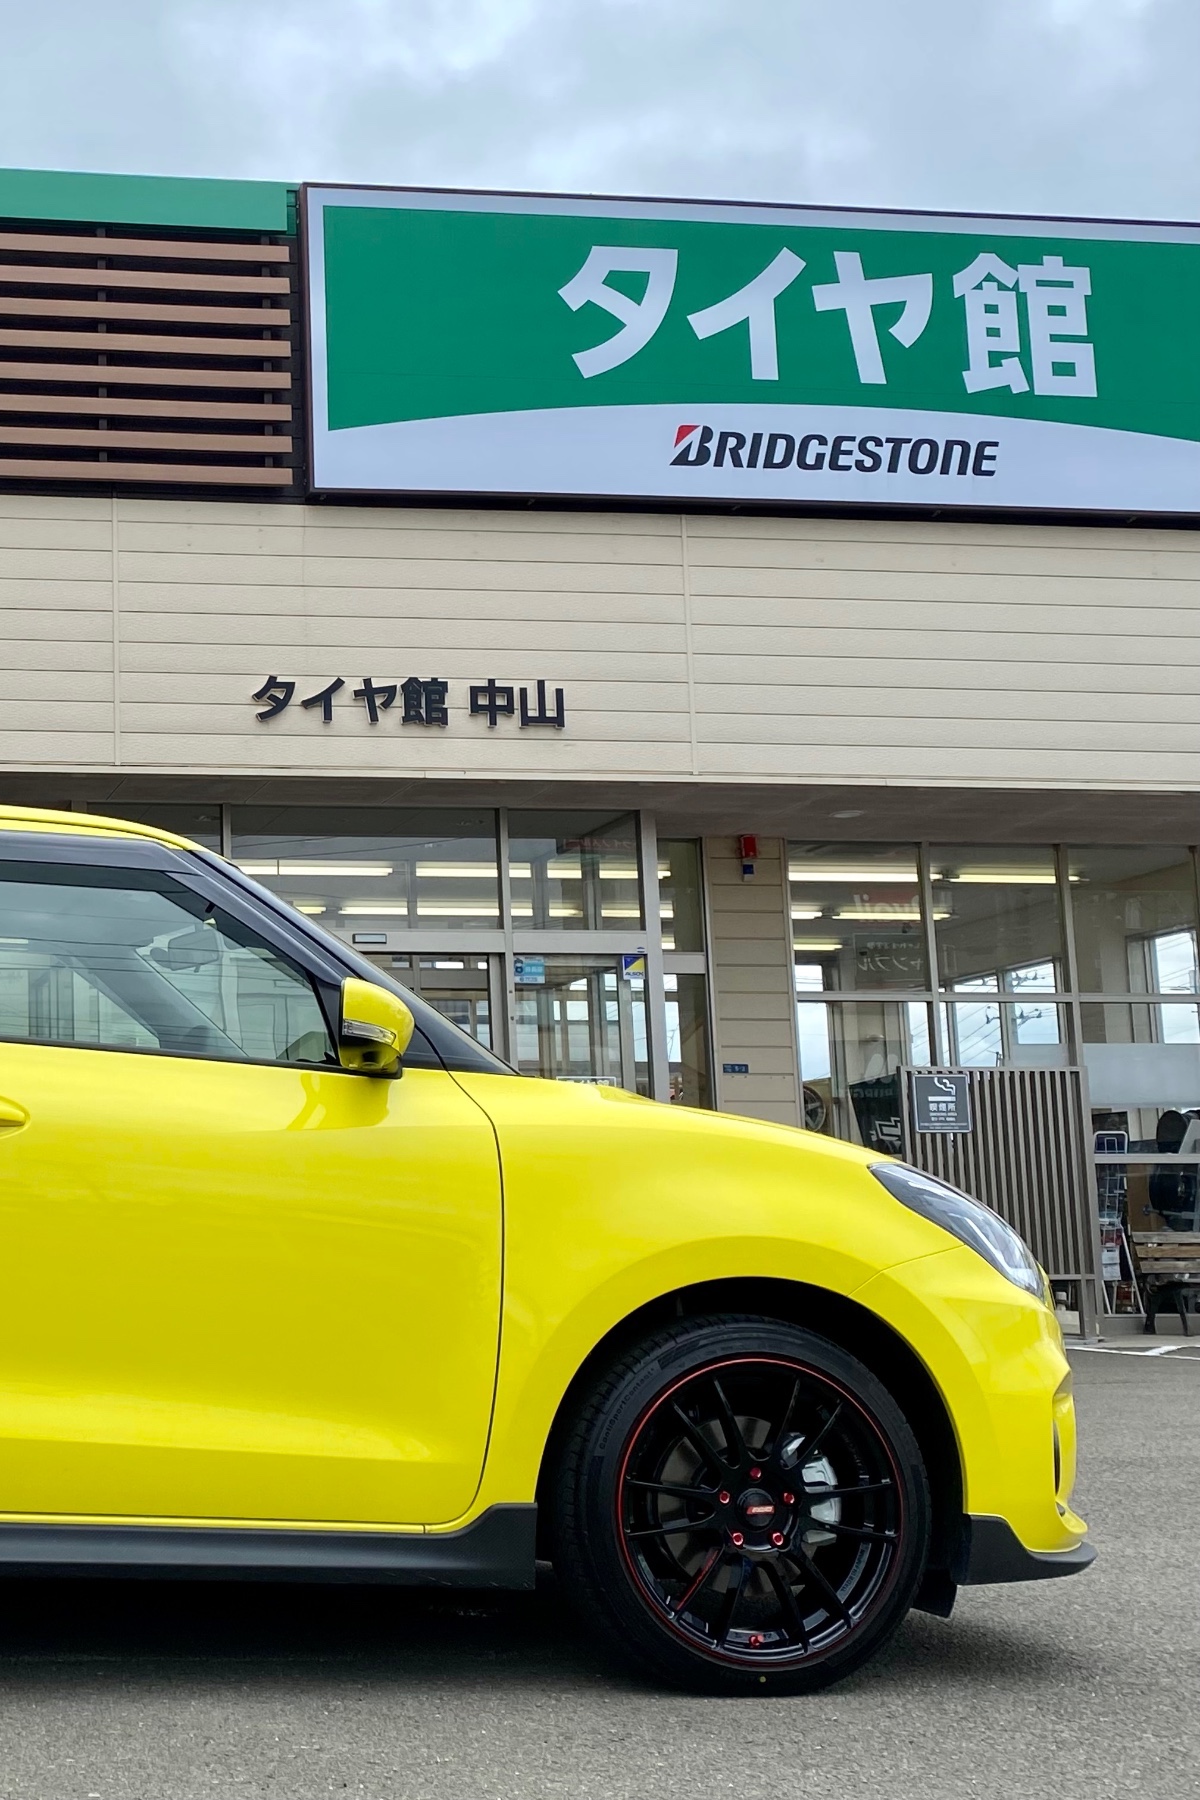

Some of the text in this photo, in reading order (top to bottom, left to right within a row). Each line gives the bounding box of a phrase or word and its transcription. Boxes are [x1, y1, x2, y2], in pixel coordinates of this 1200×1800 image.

[557, 245, 1097, 398] タイヤ館
[669, 424, 1000, 477] BRIDGESTONE
[252, 674, 566, 729] タイヤ館 中山
[929, 1103, 956, 1112] 喫煙所
